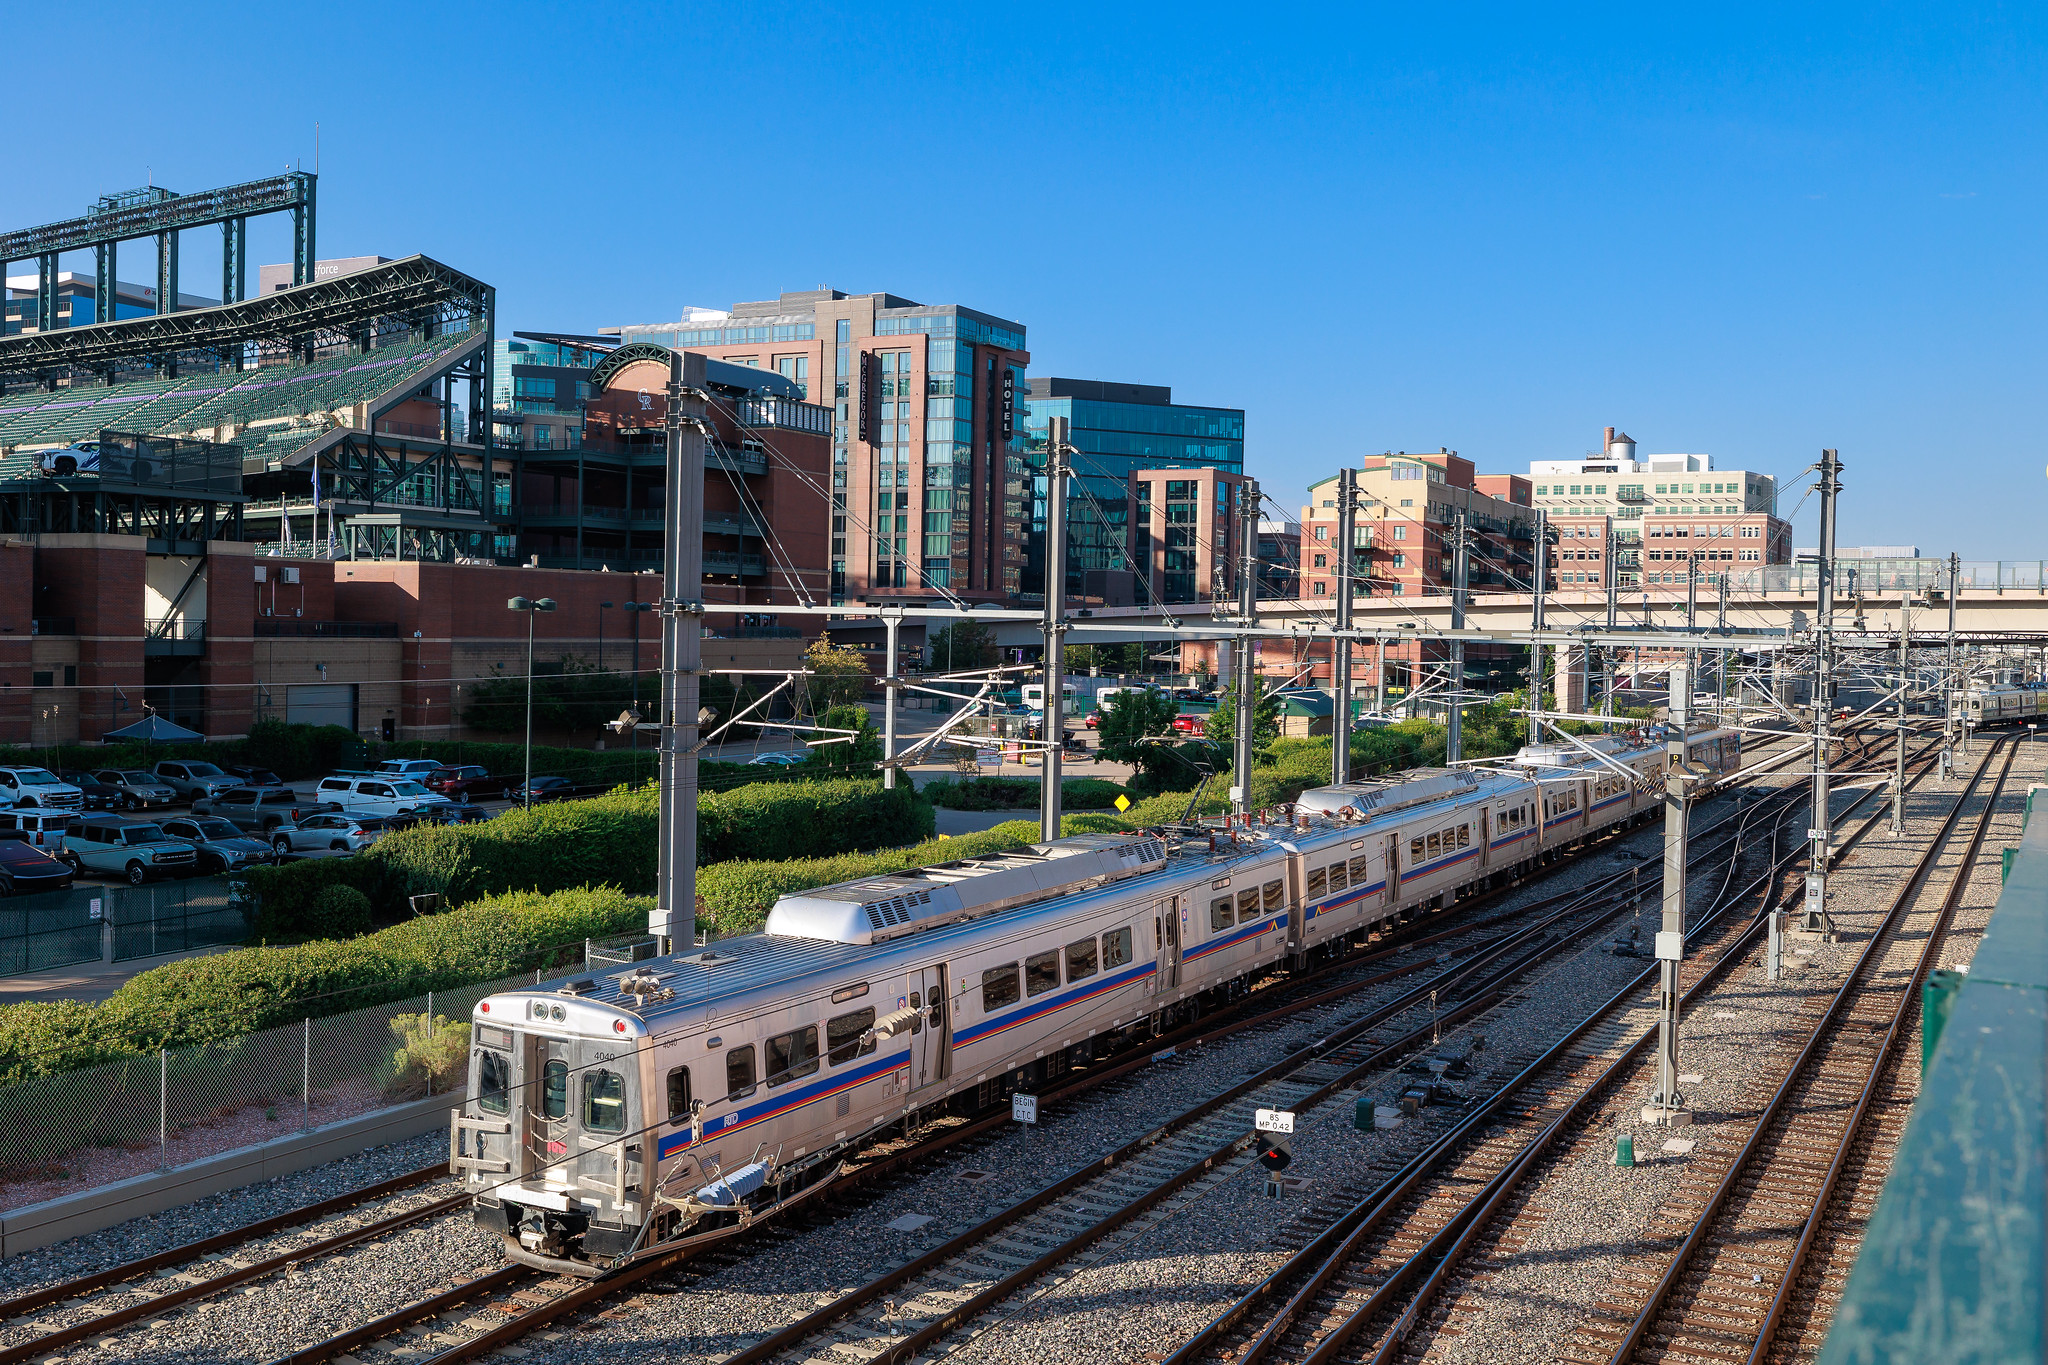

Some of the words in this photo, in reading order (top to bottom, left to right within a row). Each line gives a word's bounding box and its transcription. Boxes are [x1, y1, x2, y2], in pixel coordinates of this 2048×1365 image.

[1003, 379, 1011, 431] HOTEL
[322, 666, 327, 681] 6
[662, 1037, 678, 1050] 4040
[594, 1051, 615, 1062] 4040
[1014, 1096, 1034, 1108] BEGIN
[723, 1112, 739, 1128] RTD
[1269, 1113, 1280, 1122] 8S
[1258, 1120, 1271, 1129] MP
[1272, 1121, 1290, 1131] 0.42
